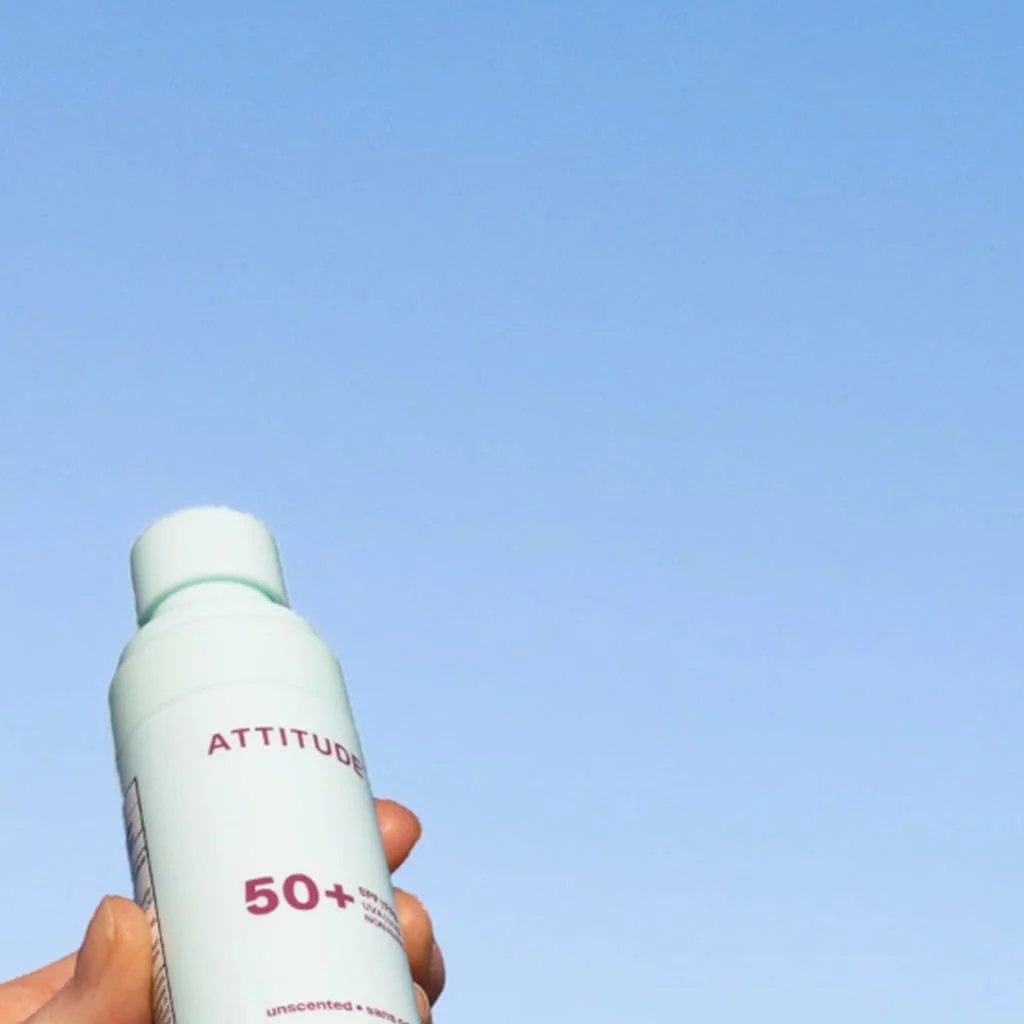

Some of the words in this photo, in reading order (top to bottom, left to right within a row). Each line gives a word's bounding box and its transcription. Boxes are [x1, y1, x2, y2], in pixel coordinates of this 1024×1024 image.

[208, 726, 364, 779] ATTITUDE
[244, 873, 354, 916] 50+
[266, 1000, 352, 1017] unscented
